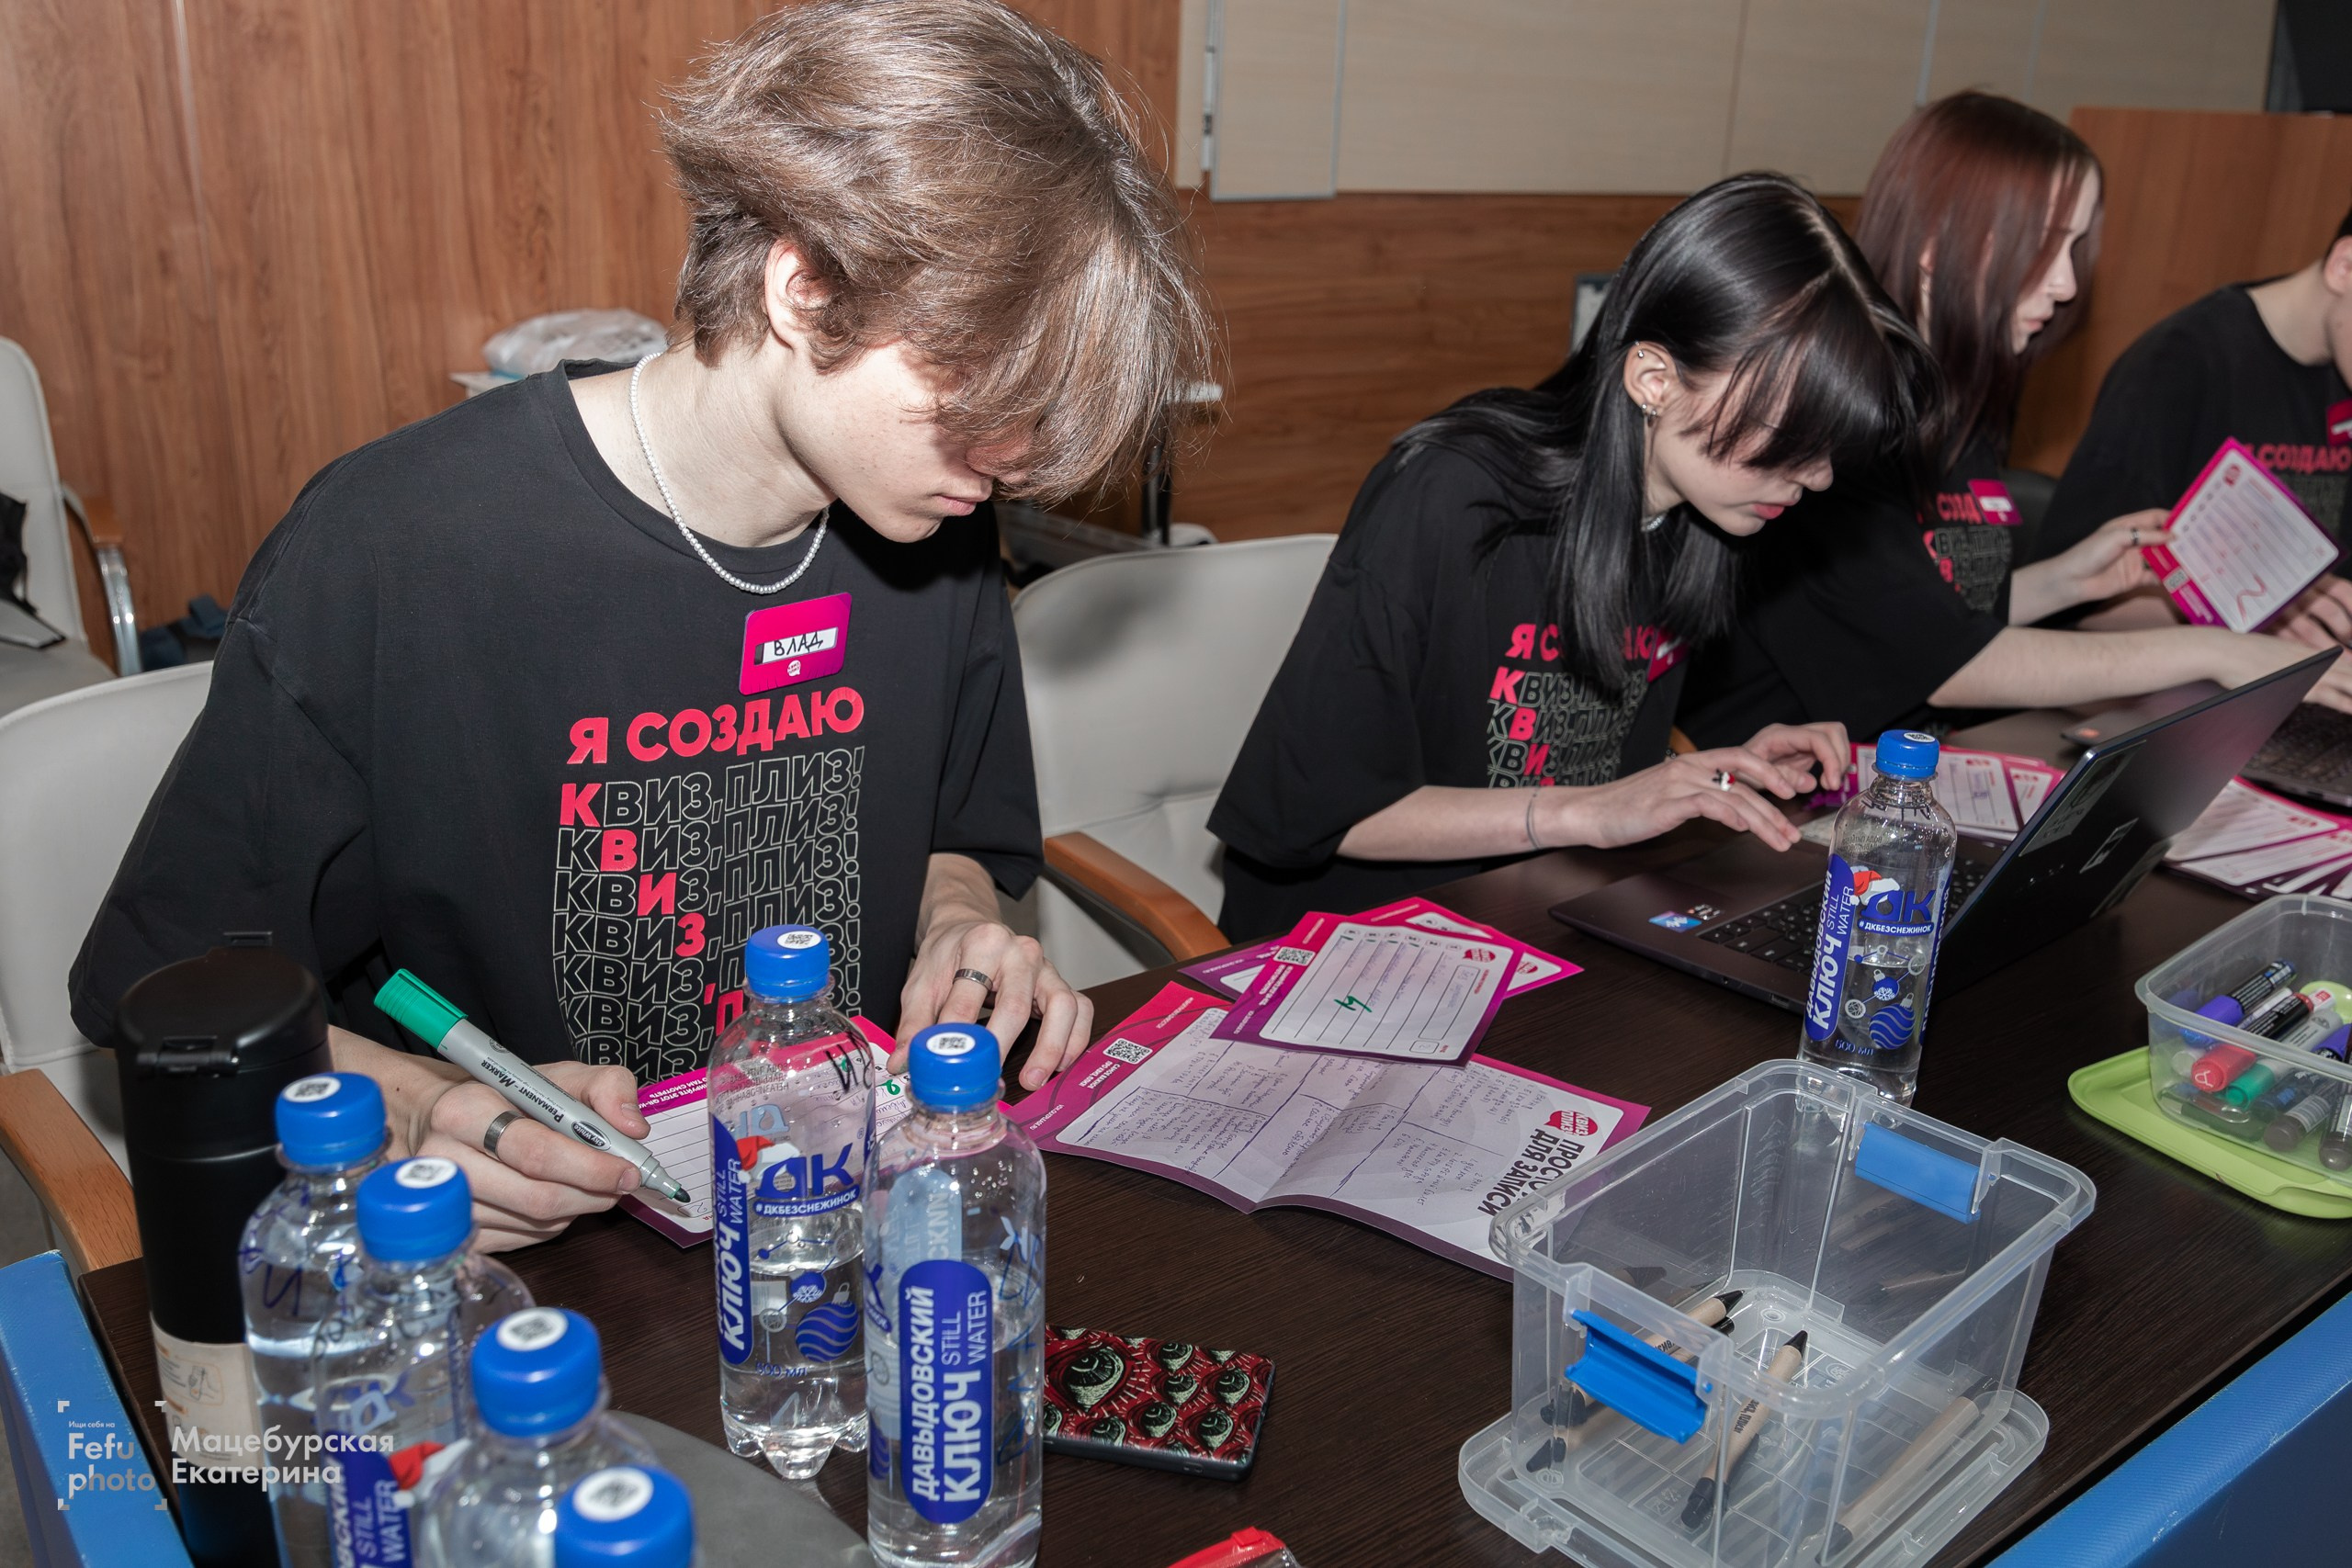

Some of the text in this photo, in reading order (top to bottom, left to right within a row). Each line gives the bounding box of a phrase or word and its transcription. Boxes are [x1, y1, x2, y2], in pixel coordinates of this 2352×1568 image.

[773, 631, 824, 658] ВЛАД
[1505, 624, 1537, 660] Я
[567, 686, 865, 764] Я СОЗДАЮ
[560, 746, 865, 827] КВИЗ, ПЛИЗ!
[555, 789, 860, 872] КВИЗ, ПЛИЗ!
[553, 831, 860, 918] КВИЗ, ПЛИЗ!
[553, 912, 721, 961] КВИЗ,
[1826, 894, 1840, 930] STILL
[1837, 886, 1854, 935] WATER
[553, 954, 717, 1006] КВИЗ,
[1812, 933, 1842, 1030] КЛЮЧ
[649, 1084, 685, 1097] СМОТРЕТЬ
[660, 1092, 678, 1101] ЭТОТ
[1522, 1129, 1558, 1161] ДЛЯ
[717, 1169, 728, 1217] STILL
[728, 1158, 743, 1224] WATER
[1478, 1161, 1536, 1214] ЗАПИСИ
[721, 1221, 745, 1350] КЛЮЧ
[941, 1310, 962, 1366] STILL
[967, 1290, 987, 1364] WATER
[910, 1285, 936, 1501] ДАВЫДОВСКИЙ
[944, 1371, 982, 1502] КЛЮЧ
[354, 1497, 377, 1558] STILL
[374, 1480, 405, 1562] WATER
